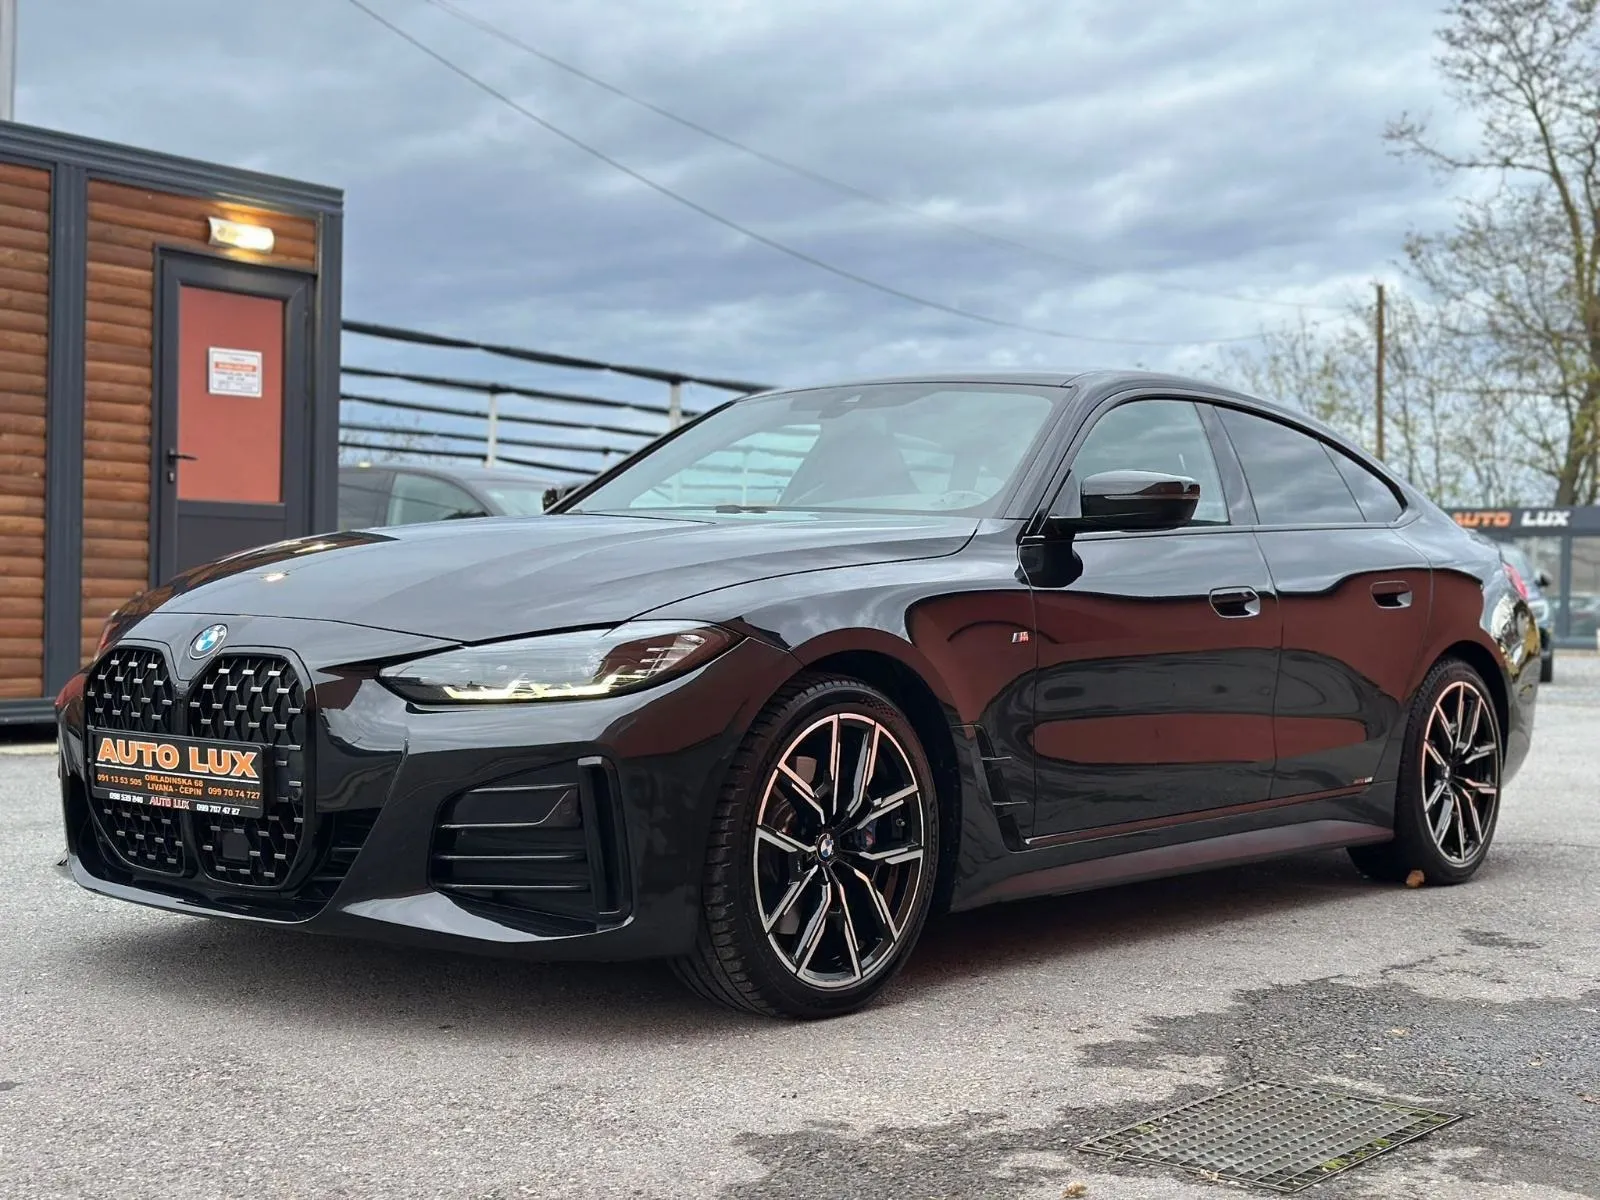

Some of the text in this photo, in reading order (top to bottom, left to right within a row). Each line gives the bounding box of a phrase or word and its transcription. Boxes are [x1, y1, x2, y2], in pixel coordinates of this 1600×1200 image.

[1520, 510, 1571, 527] LUX
[97, 737, 259, 778] AUTO LUX
[97, 774, 109, 782] 091
[120, 776, 129, 784] 53
[130, 778, 142, 786] 505
[145, 774, 193, 786] OMLADINSKA
[147, 782, 174, 792] LIVANA
[179, 785, 202, 796] ČEPIN
[208, 787, 222, 796] 099
[247, 791, 260, 799] 727
[149, 796, 190, 810] AUTO LUX
